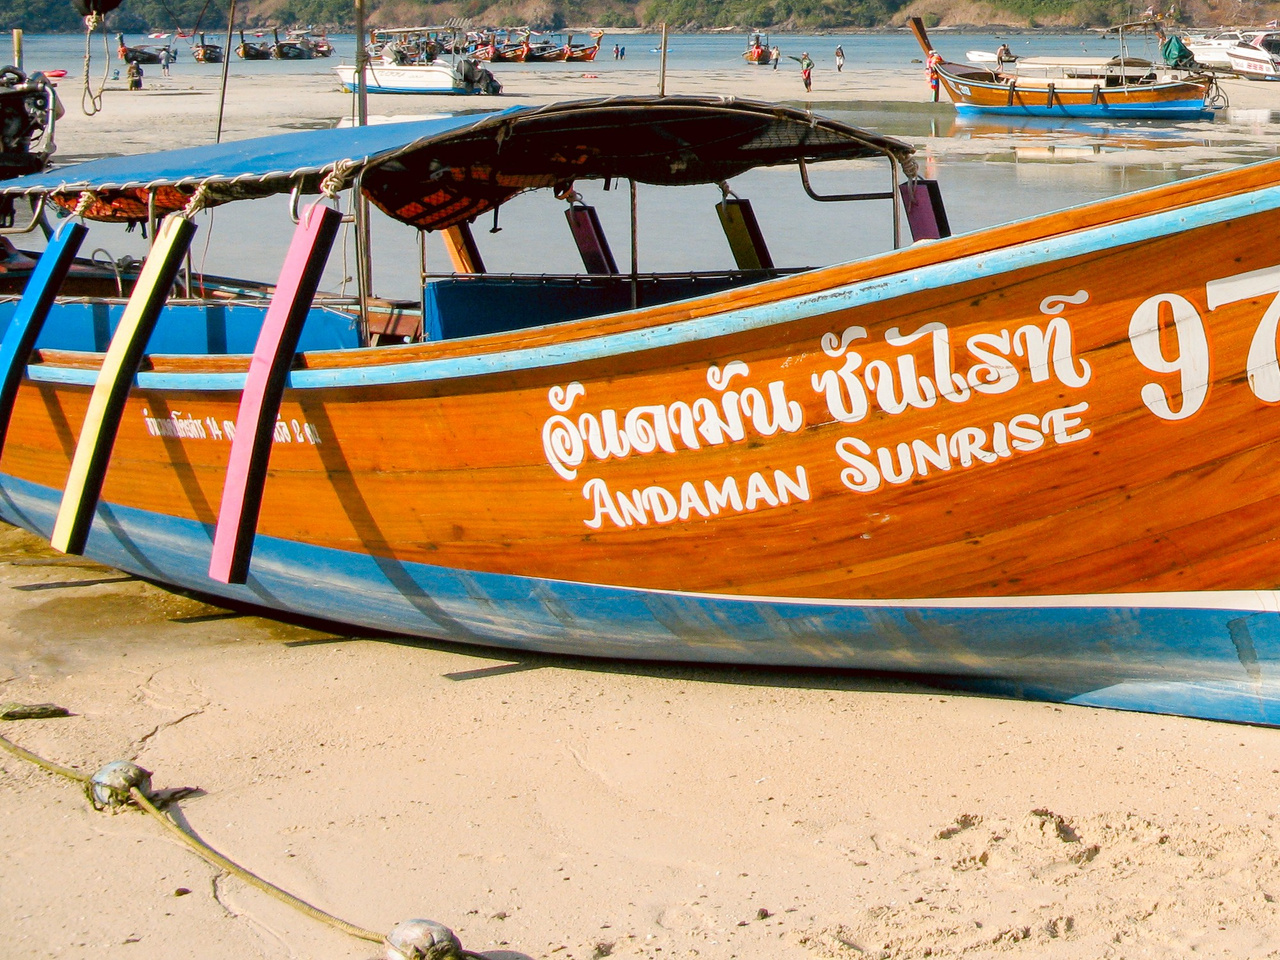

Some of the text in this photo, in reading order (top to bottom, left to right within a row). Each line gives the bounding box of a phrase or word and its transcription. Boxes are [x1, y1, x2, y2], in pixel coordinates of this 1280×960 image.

[205, 416, 223, 440] 14
[291, 419, 305, 443] 2
[541, 360, 803, 480] อันดามัน
[582, 401, 1092, 529] ANDAMAN SUNRISE
